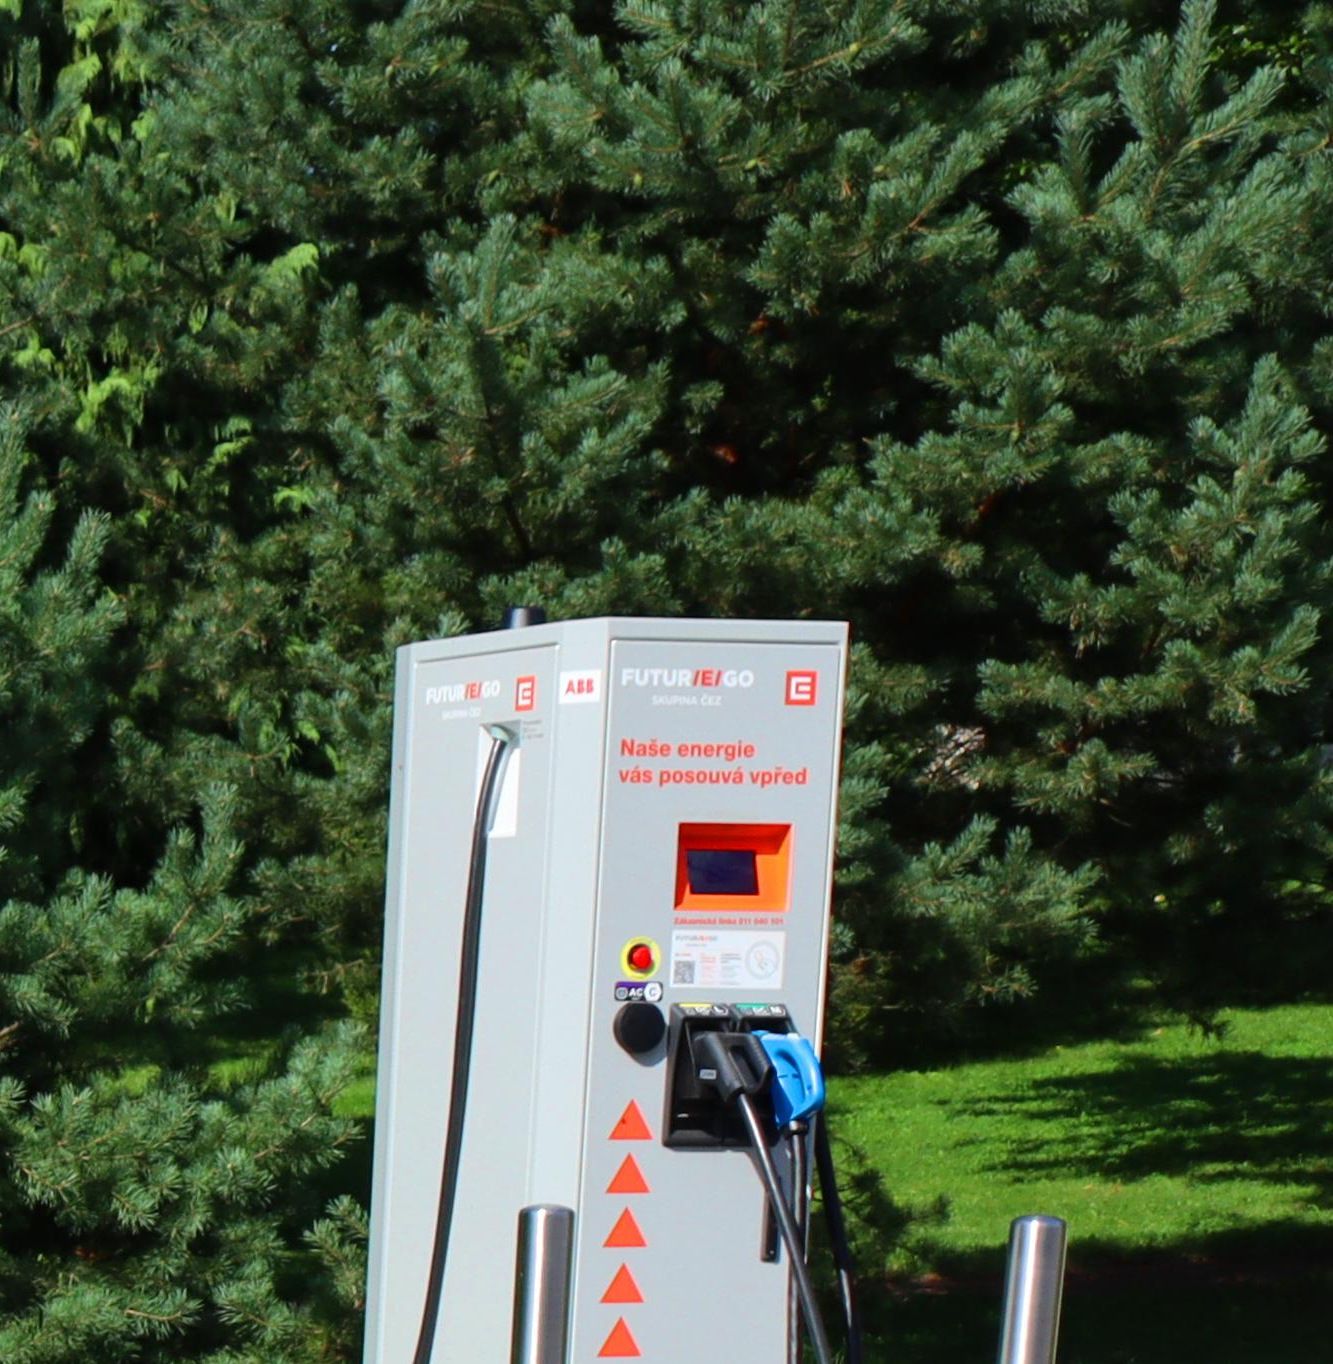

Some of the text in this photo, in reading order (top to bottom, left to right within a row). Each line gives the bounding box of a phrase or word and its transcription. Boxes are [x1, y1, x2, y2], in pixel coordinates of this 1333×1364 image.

[564, 678, 595, 695] ABB
[700, 693, 723, 706] ČEZ
[619, 738, 755, 761] Naše energie
[619, 766, 808, 788] vás posouvá vpřed
[628, 987, 644, 998] AC
